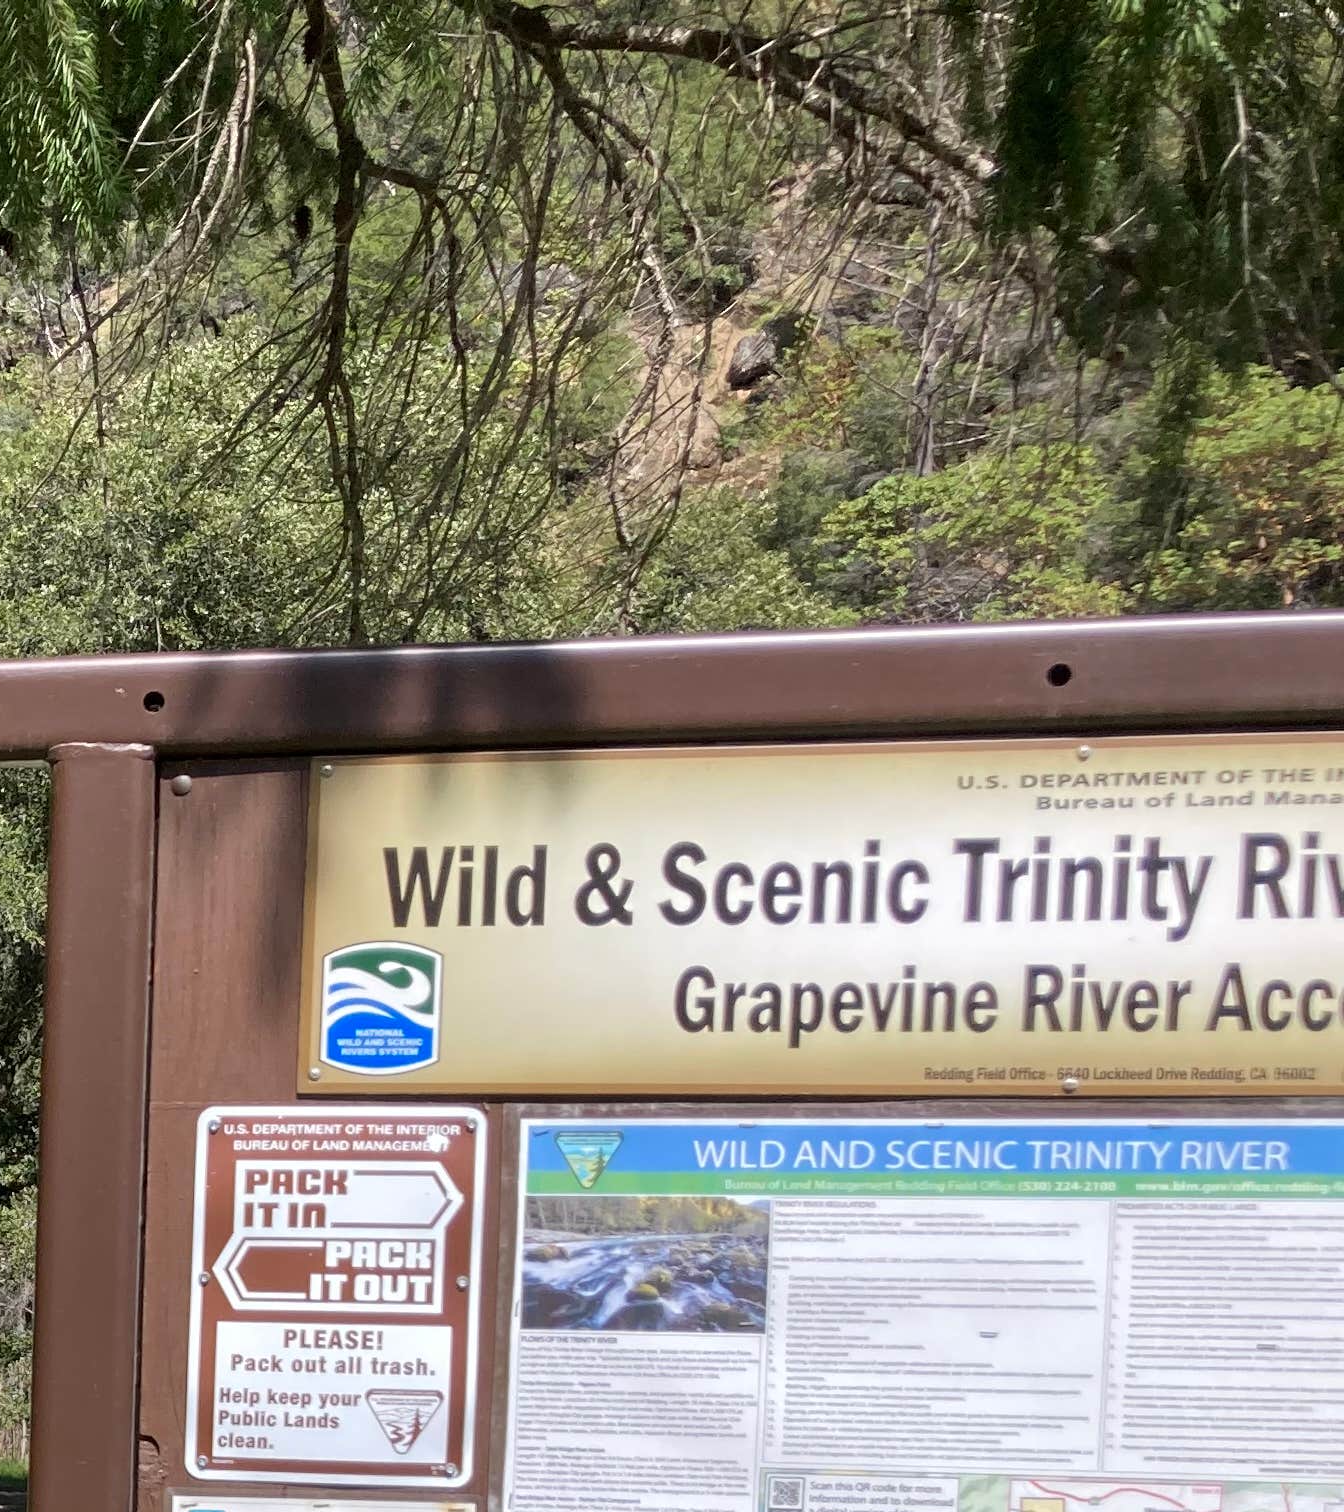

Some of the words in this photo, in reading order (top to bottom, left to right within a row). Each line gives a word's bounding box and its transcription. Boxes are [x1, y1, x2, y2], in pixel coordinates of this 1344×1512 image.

[957, 775, 1009, 790] U.S.
[1019, 770, 1205, 789] DEPARTMENT
[1216, 769, 1253, 784] OF
[1262, 768, 1315, 783] THE
[1036, 796, 1134, 810] Bureau
[1144, 793, 1175, 808] of
[1185, 790, 1253, 807] Land
[383, 844, 548, 928] Wild
[574, 841, 634, 927] &
[658, 840, 931, 927] Scenic
[953, 835, 1215, 942] Trinity
[674, 965, 998, 1049] Grapevine
[1021, 963, 1192, 1033] River
[1205, 962, 1344, 1033] Acc
[355, 1029, 405, 1037] NATIONAL
[387, 1039, 423, 1047] SCENIC
[341, 1048, 376, 1056] RIVERS
[379, 1048, 419, 1056] SYSTEM
[924, 1067, 974, 1083] Redding
[977, 1067, 1005, 1080] Field
[1010, 1067, 1046, 1080] Office
[1093, 1067, 1152, 1080] Lockheed
[1156, 1067, 1187, 1080] Drive
[1191, 1067, 1246, 1083] Redding,
[1250, 1068, 1267, 1080] CA
[224, 1124, 250, 1135] U.S.
[253, 1124, 342, 1136] DEPARTMENT
[345, 1124, 363, 1136] OF
[366, 1124, 394, 1136] THE
[397, 1124, 461, 1136] INTERIOR
[234, 1140, 289, 1151] BUREAU
[292, 1140, 309, 1151] OF
[313, 1140, 349, 1151] LAND
[352, 1140, 449, 1152] MANAGEMET
[693, 1140, 786, 1169] WILD
[793, 1140, 876, 1169] AND
[886, 1140, 1018, 1170] SCENIC
[1026, 1141, 1173, 1170] TRINITY
[1181, 1141, 1289, 1170] RIVER
[243, 1169, 348, 1195] PACK
[725, 1179, 765, 1190] Bureau
[768, 1179, 780, 1190] of
[783, 1179, 812, 1190] Land
[814, 1180, 892, 1192] Management
[948, 1181, 977, 1191] Field
[980, 1181, 1013, 1192] Office
[243, 1202, 279, 1228] IT
[325, 1241, 432, 1268] PACK
[310, 1274, 348, 1300] IT
[354, 1275, 432, 1302] OUT
[283, 1329, 384, 1350] PLEASE!
[230, 1354, 284, 1373] Pack
[292, 1358, 327, 1373] out
[334, 1356, 362, 1374] all
[371, 1357, 436, 1376] trash.
[219, 1388, 260, 1406] Help
[267, 1389, 312, 1408] keep
[318, 1392, 362, 1409] your
[218, 1410, 277, 1427] Public
[284, 1412, 340, 1428] Lands
[217, 1433, 275, 1449] clean.
[810, 1482, 833, 1490] Scan
[835, 1482, 853, 1491] this
[855, 1482, 870, 1492] QR
[872, 1484, 897, 1493] code
[899, 1484, 912, 1493] for
[869, 1496, 889, 1505] and
[890, 1497, 901, 1505] to
